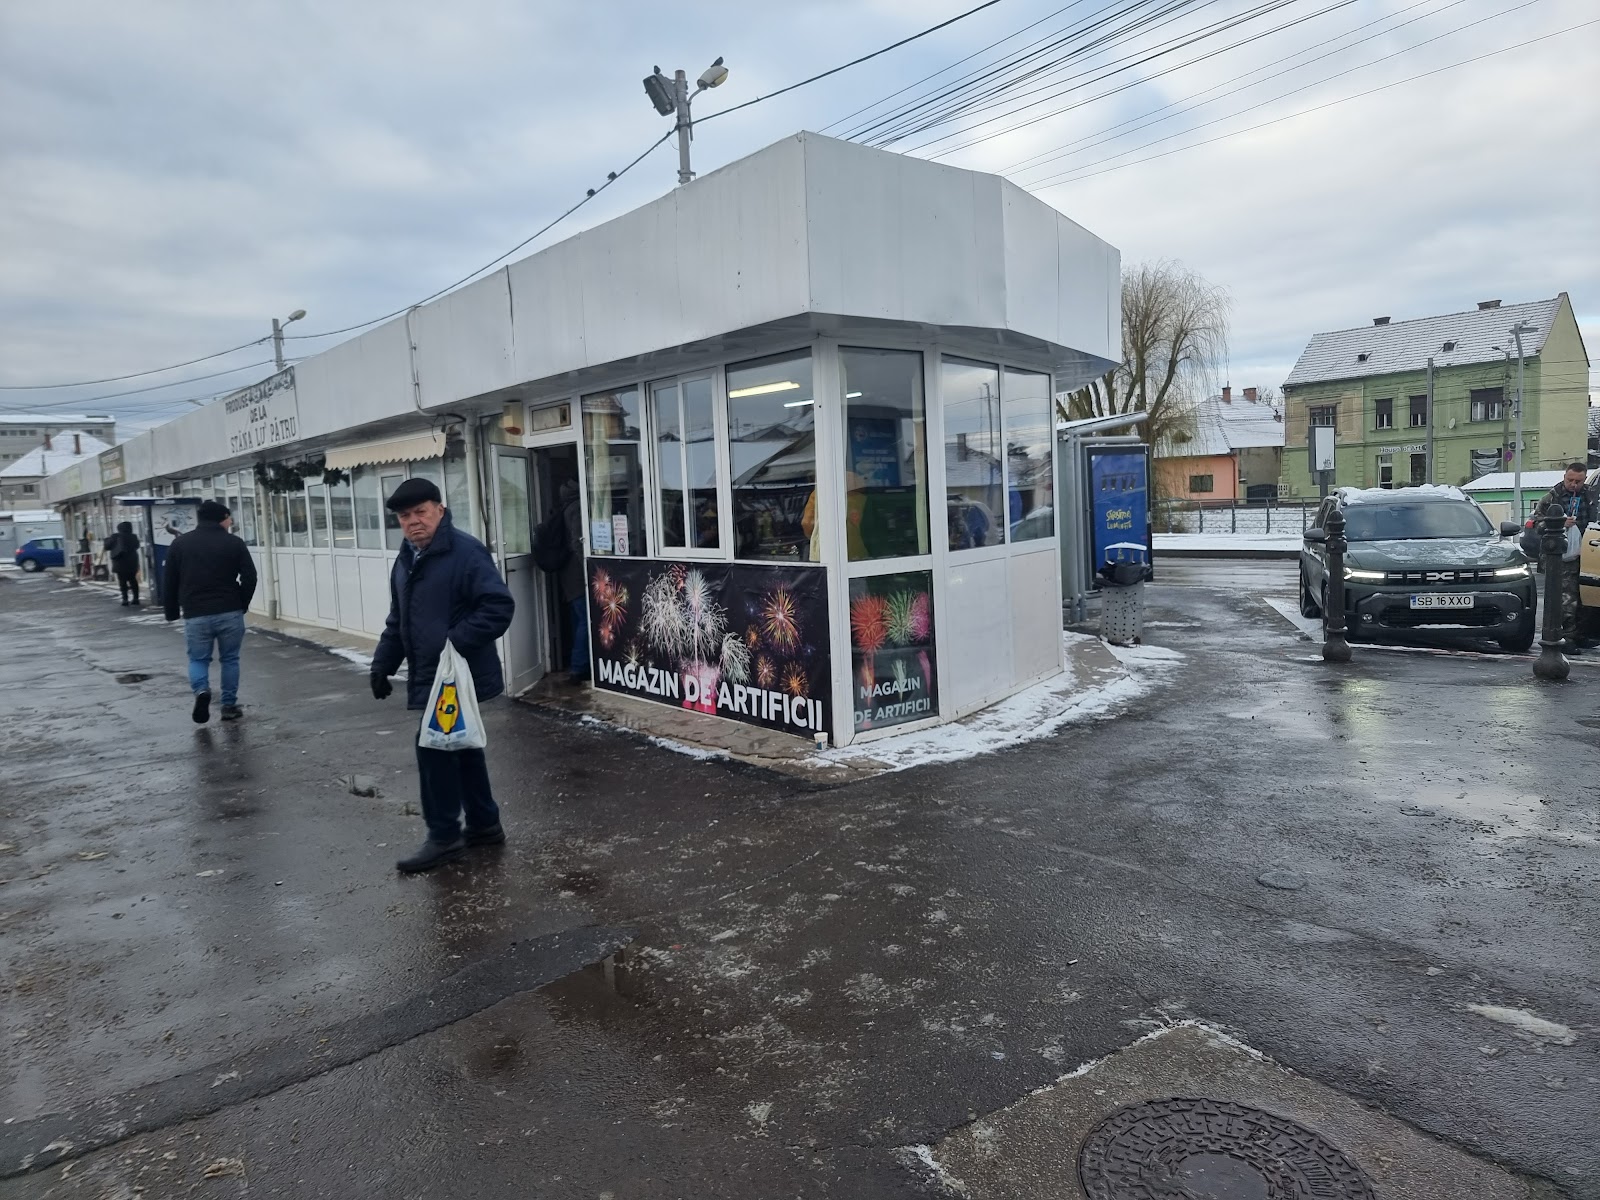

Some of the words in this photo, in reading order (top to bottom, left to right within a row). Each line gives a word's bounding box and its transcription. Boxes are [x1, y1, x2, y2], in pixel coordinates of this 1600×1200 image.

[250, 408, 259, 423] DE
[258, 405, 267, 420] LA
[1417, 596, 1433, 606] SB
[1436, 596, 1447, 606] 16
[598, 657, 679, 699] MAGAZIN
[685, 674, 712, 707] DE
[717, 682, 823, 732] ARTIFICII
[860, 676, 921, 699] MAGAZIN
[854, 708, 873, 725] DE
[874, 697, 931, 721] ARTIFICII
